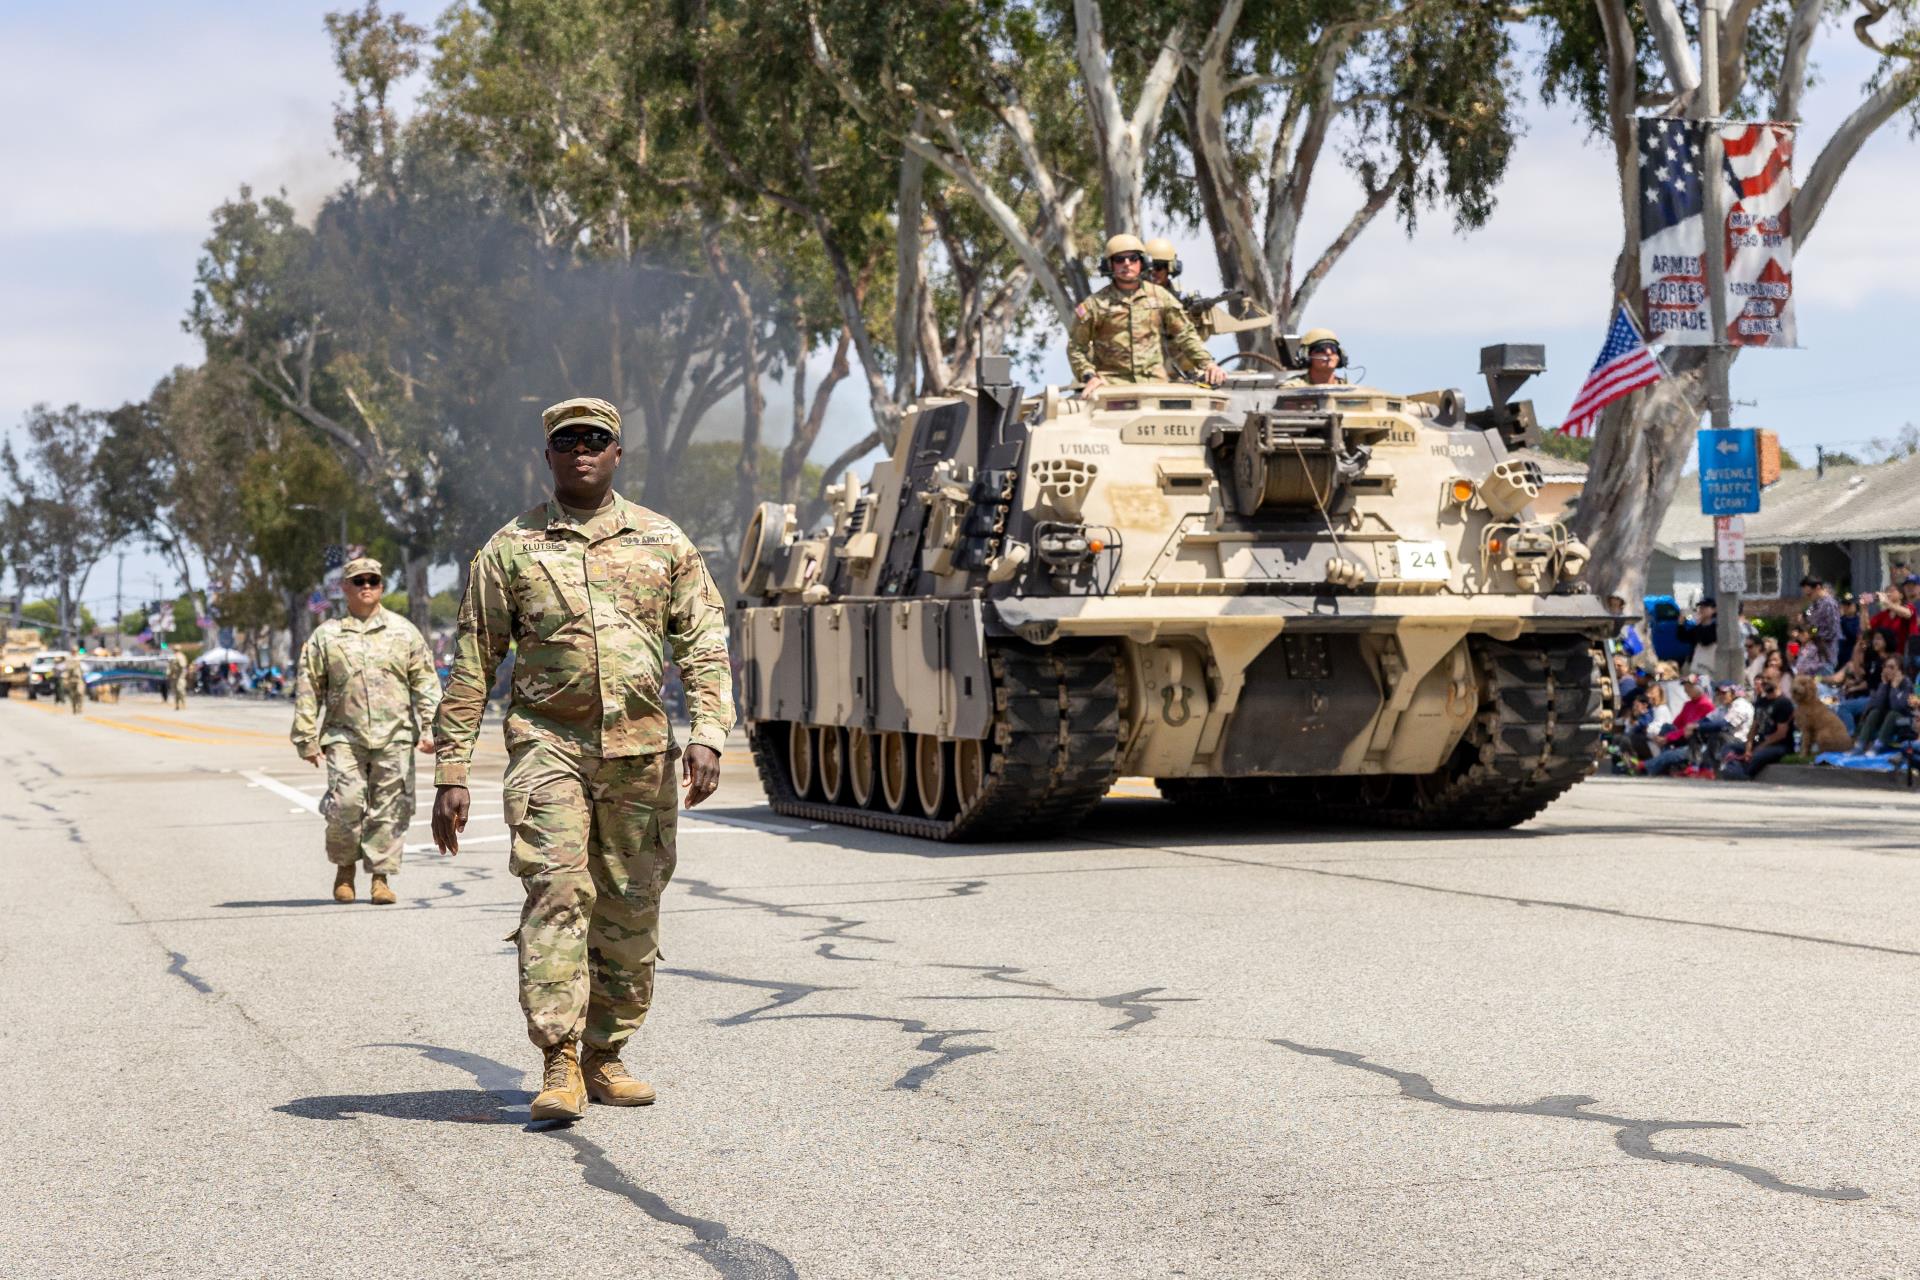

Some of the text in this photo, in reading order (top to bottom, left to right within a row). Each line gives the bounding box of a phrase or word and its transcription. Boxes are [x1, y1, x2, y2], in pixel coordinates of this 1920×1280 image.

[1652, 255, 1699, 274] ARMED
[1650, 282, 1704, 304] FORCES
[1651, 311, 1707, 331] PARADE
[1137, 425, 1196, 436] SGT SEELY
[1704, 468, 1753, 481] JUVENILE
[1708, 483, 1751, 495] TRAFFIC
[1713, 497, 1748, 510] COURT
[1410, 551, 1437, 568] 24
